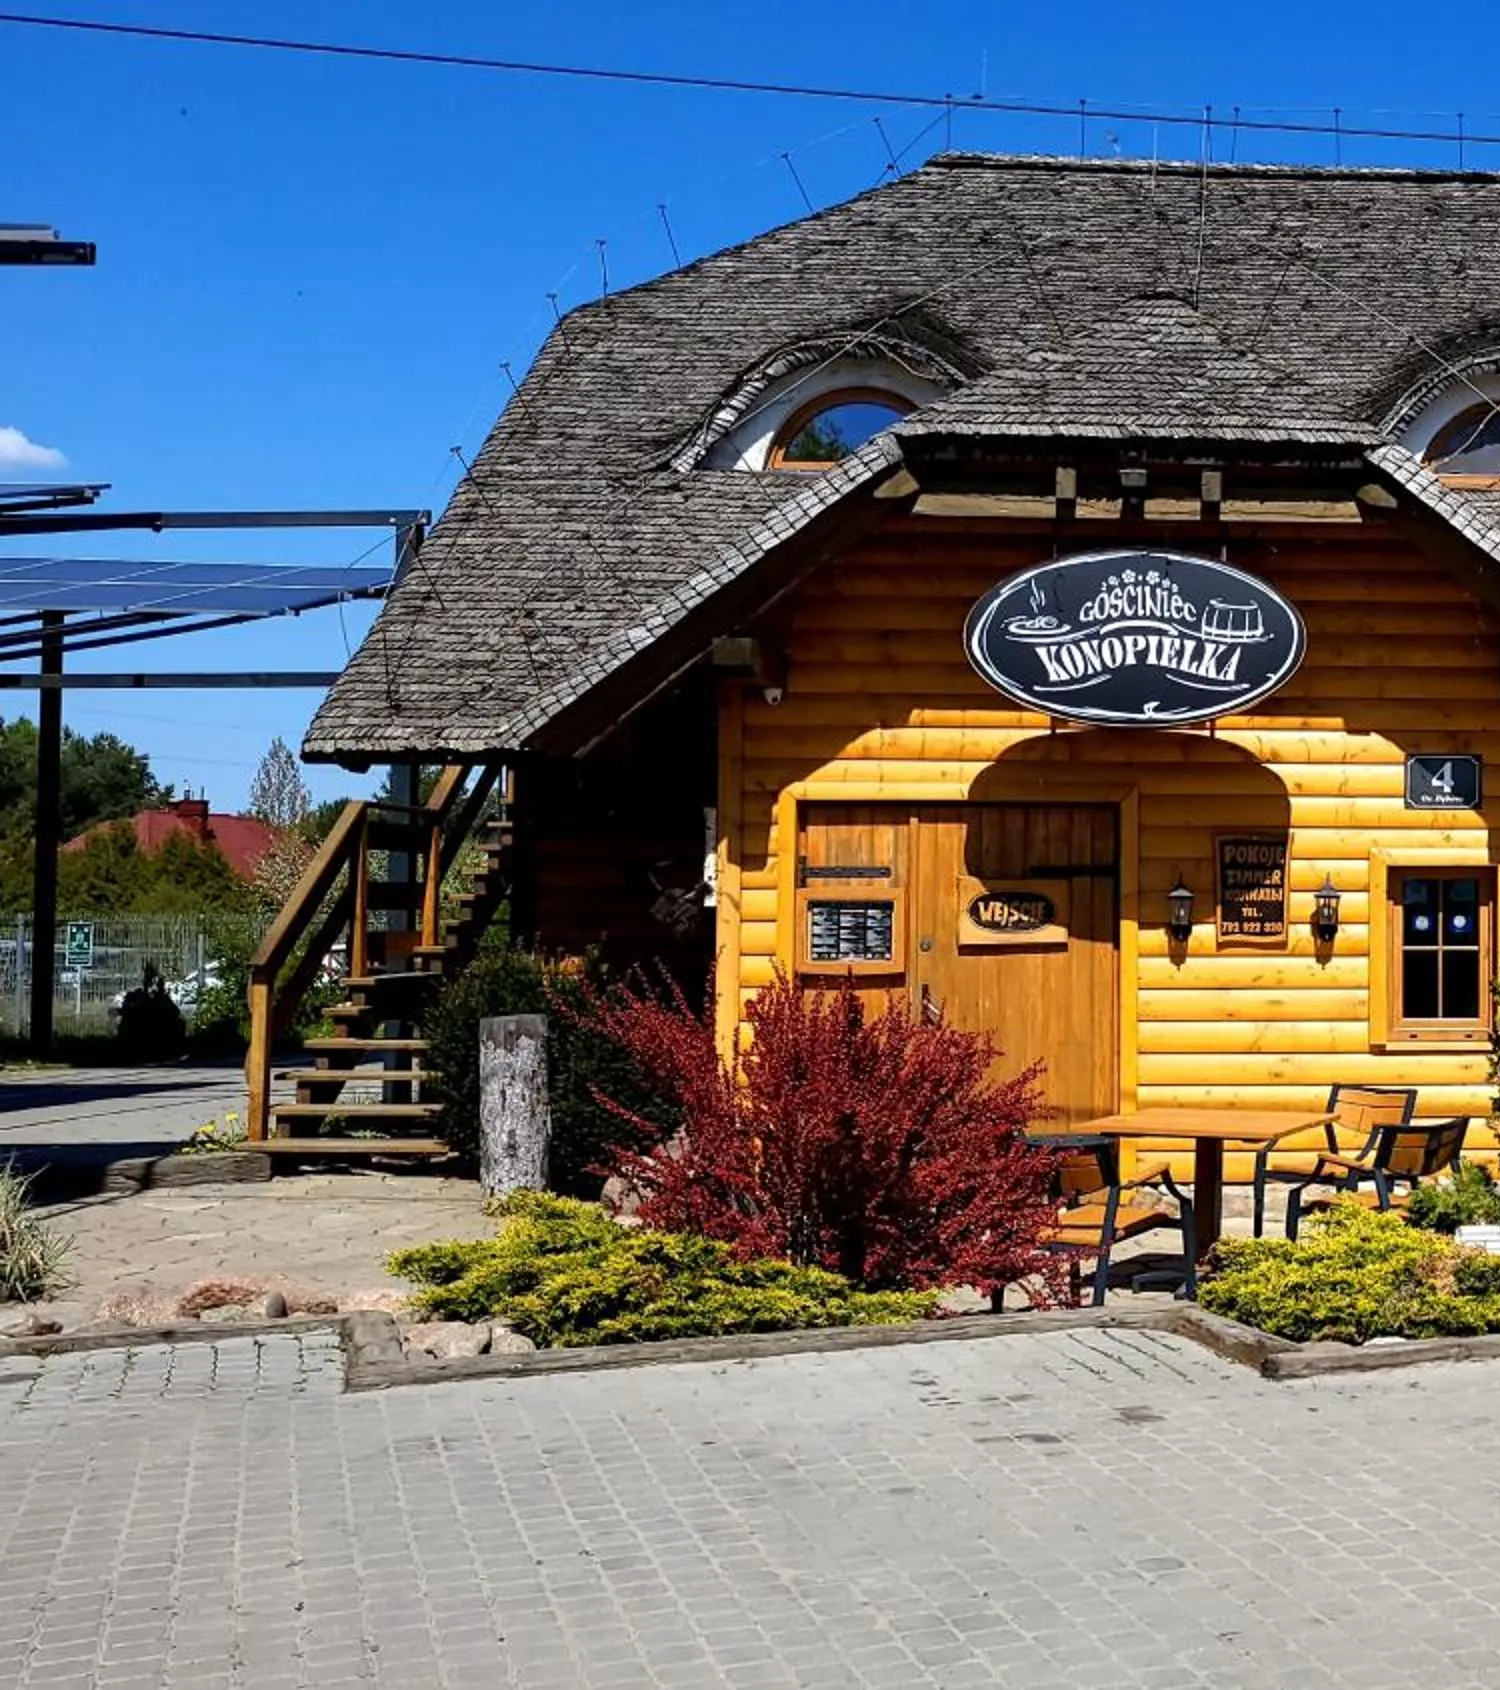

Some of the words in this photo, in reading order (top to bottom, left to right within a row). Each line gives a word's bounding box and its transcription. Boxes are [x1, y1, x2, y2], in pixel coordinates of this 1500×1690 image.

[1034, 635, 1242, 682] KONOPIELKA
[1431, 761, 1455, 793] 4
[1224, 846, 1285, 865] POKOJE
